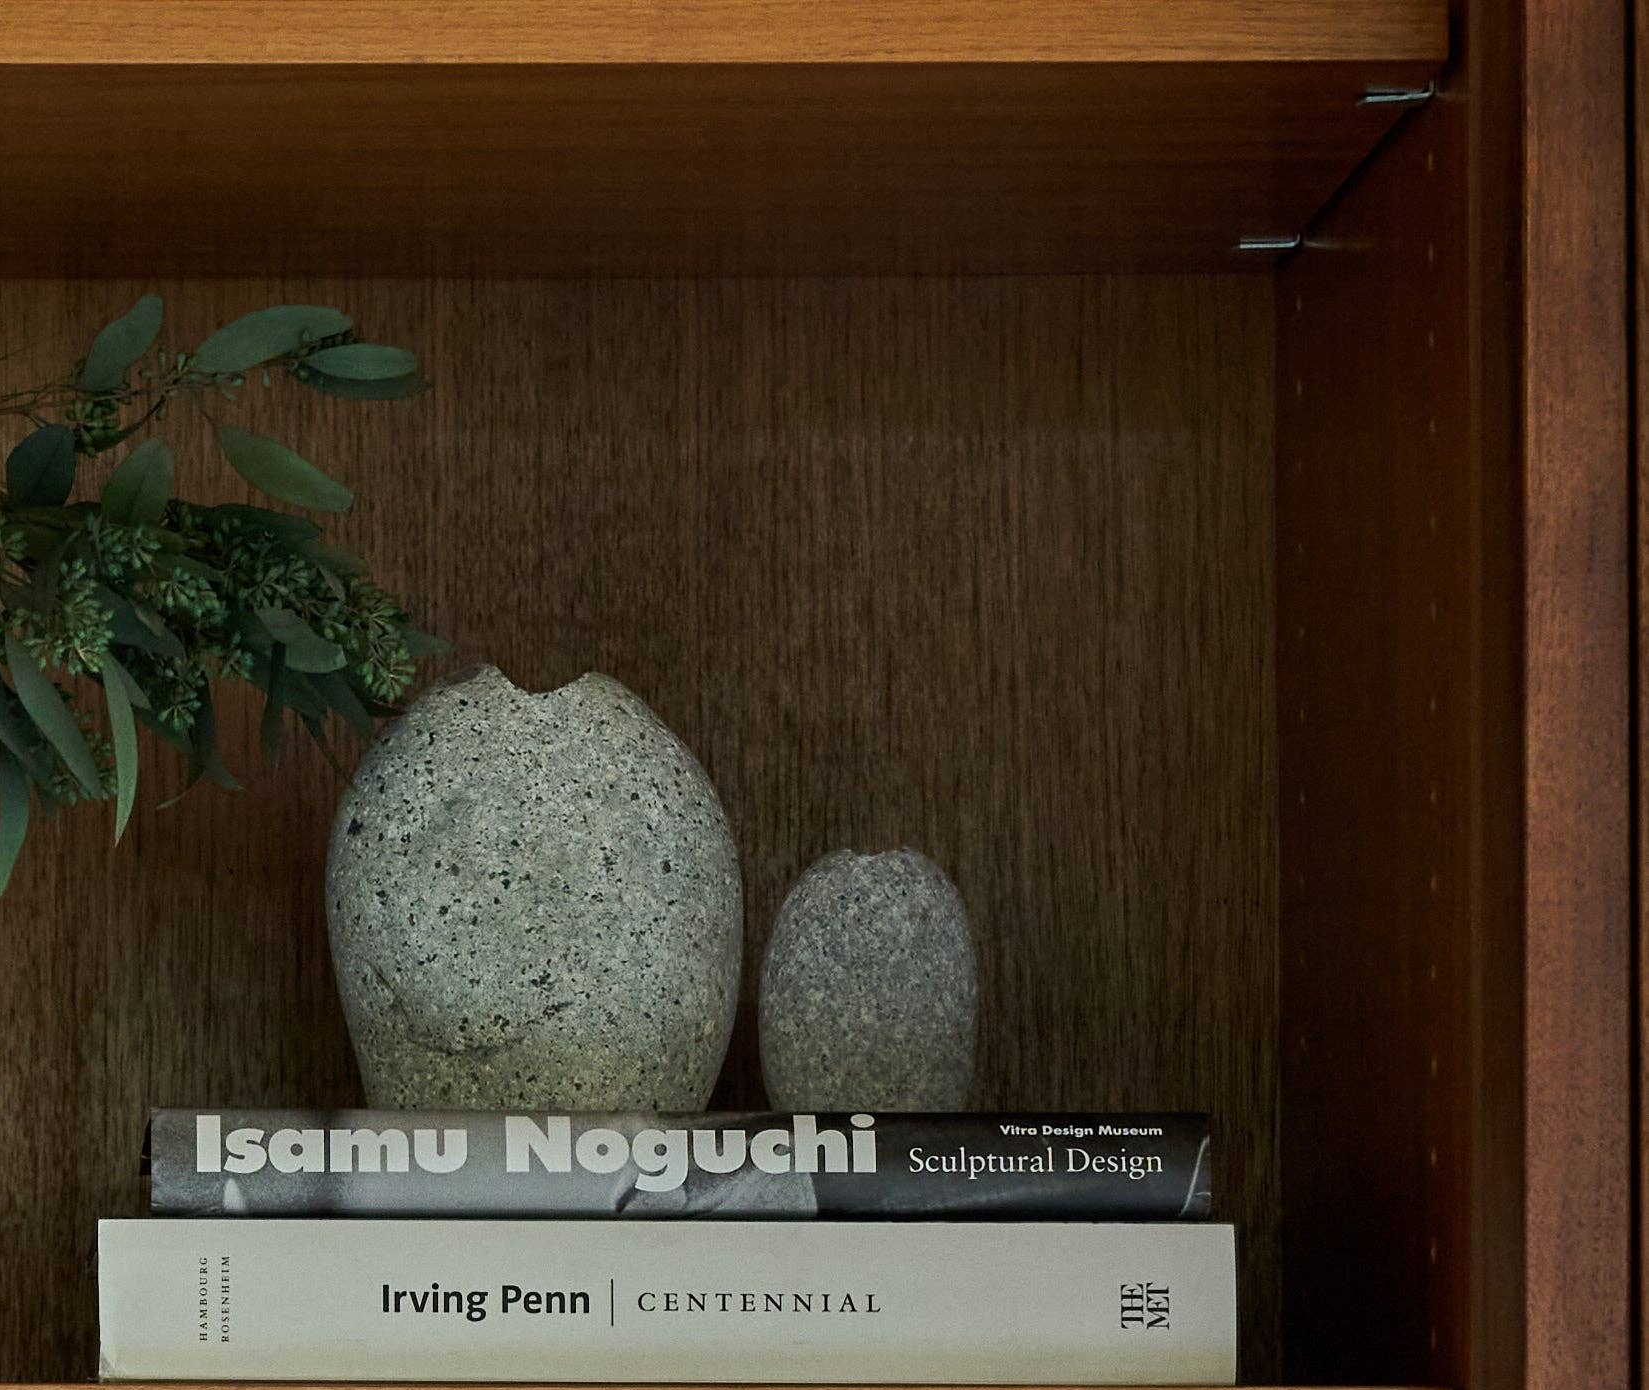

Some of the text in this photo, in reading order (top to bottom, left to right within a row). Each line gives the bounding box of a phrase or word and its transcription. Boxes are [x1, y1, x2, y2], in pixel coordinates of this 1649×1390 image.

[196, 1113, 877, 1193] Isamu Noguchi
[1000, 1125, 1163, 1138] Vitra Design Museum
[908, 1146, 1163, 1181] Sculptural Design
[199, 1257, 208, 1341] HAMBOURG
[221, 1256, 230, 1342] ROSENHEIM
[382, 1283, 591, 1322] Irving Penn
[637, 1293, 881, 1314] CENTENNIAL
[1121, 1283, 1145, 1329] THE
[1146, 1282, 1170, 1330] MET
